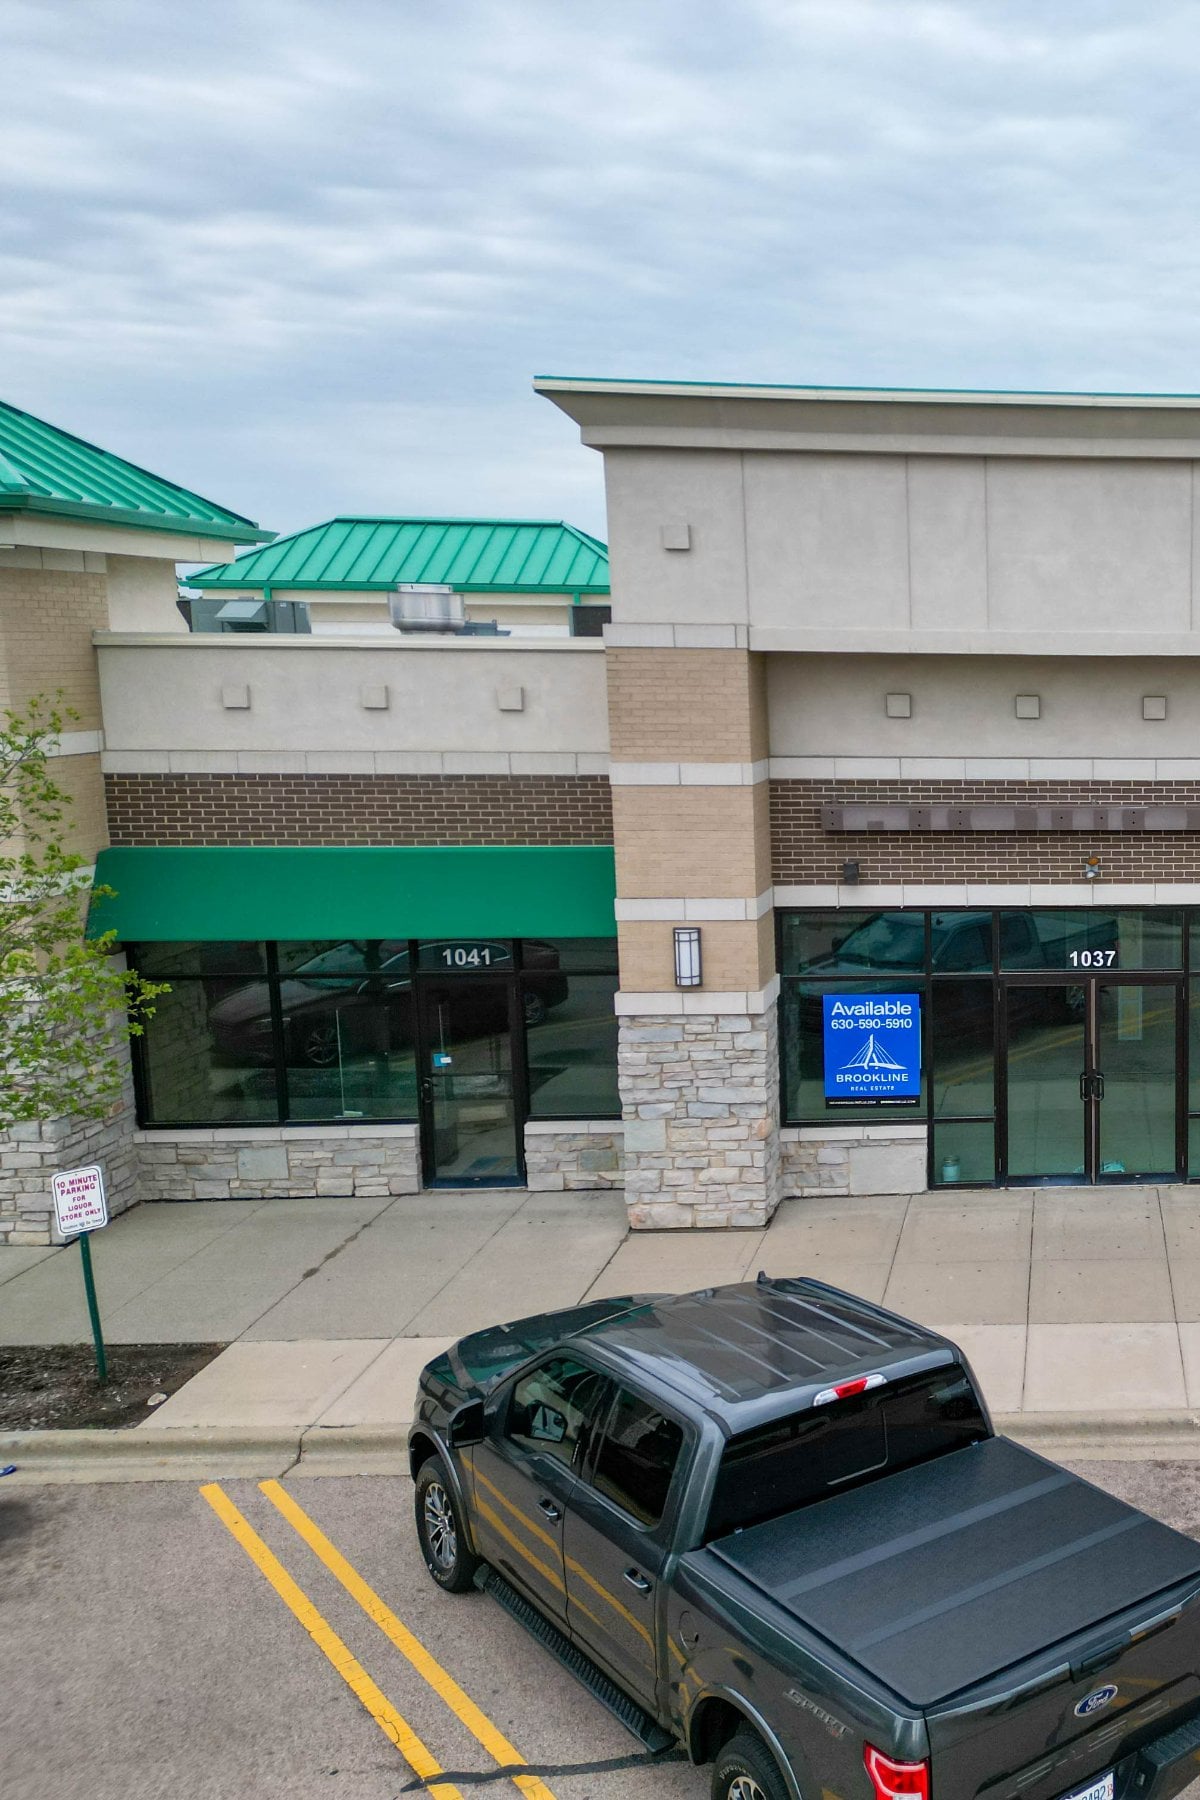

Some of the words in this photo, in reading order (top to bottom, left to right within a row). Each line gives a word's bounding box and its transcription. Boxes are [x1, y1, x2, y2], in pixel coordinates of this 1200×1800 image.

[442, 948, 490, 965] 1041
[1069, 950, 1116, 967] 1037
[831, 1001, 912, 1016] Available
[831, 1018, 912, 1029] 630-590-5910
[836, 1073, 909, 1083] BROOKLINE
[57, 1181, 65, 1189] 10
[69, 1174, 97, 1186] MINUTE
[61, 1183, 95, 1196] PARKING
[73, 1195, 86, 1203] FOR
[68, 1201, 92, 1212] LIQUOR
[61, 1212, 82, 1222] STORE
[85, 1208, 101, 1216] ONLY
[783, 1688, 854, 1736] SPORT
